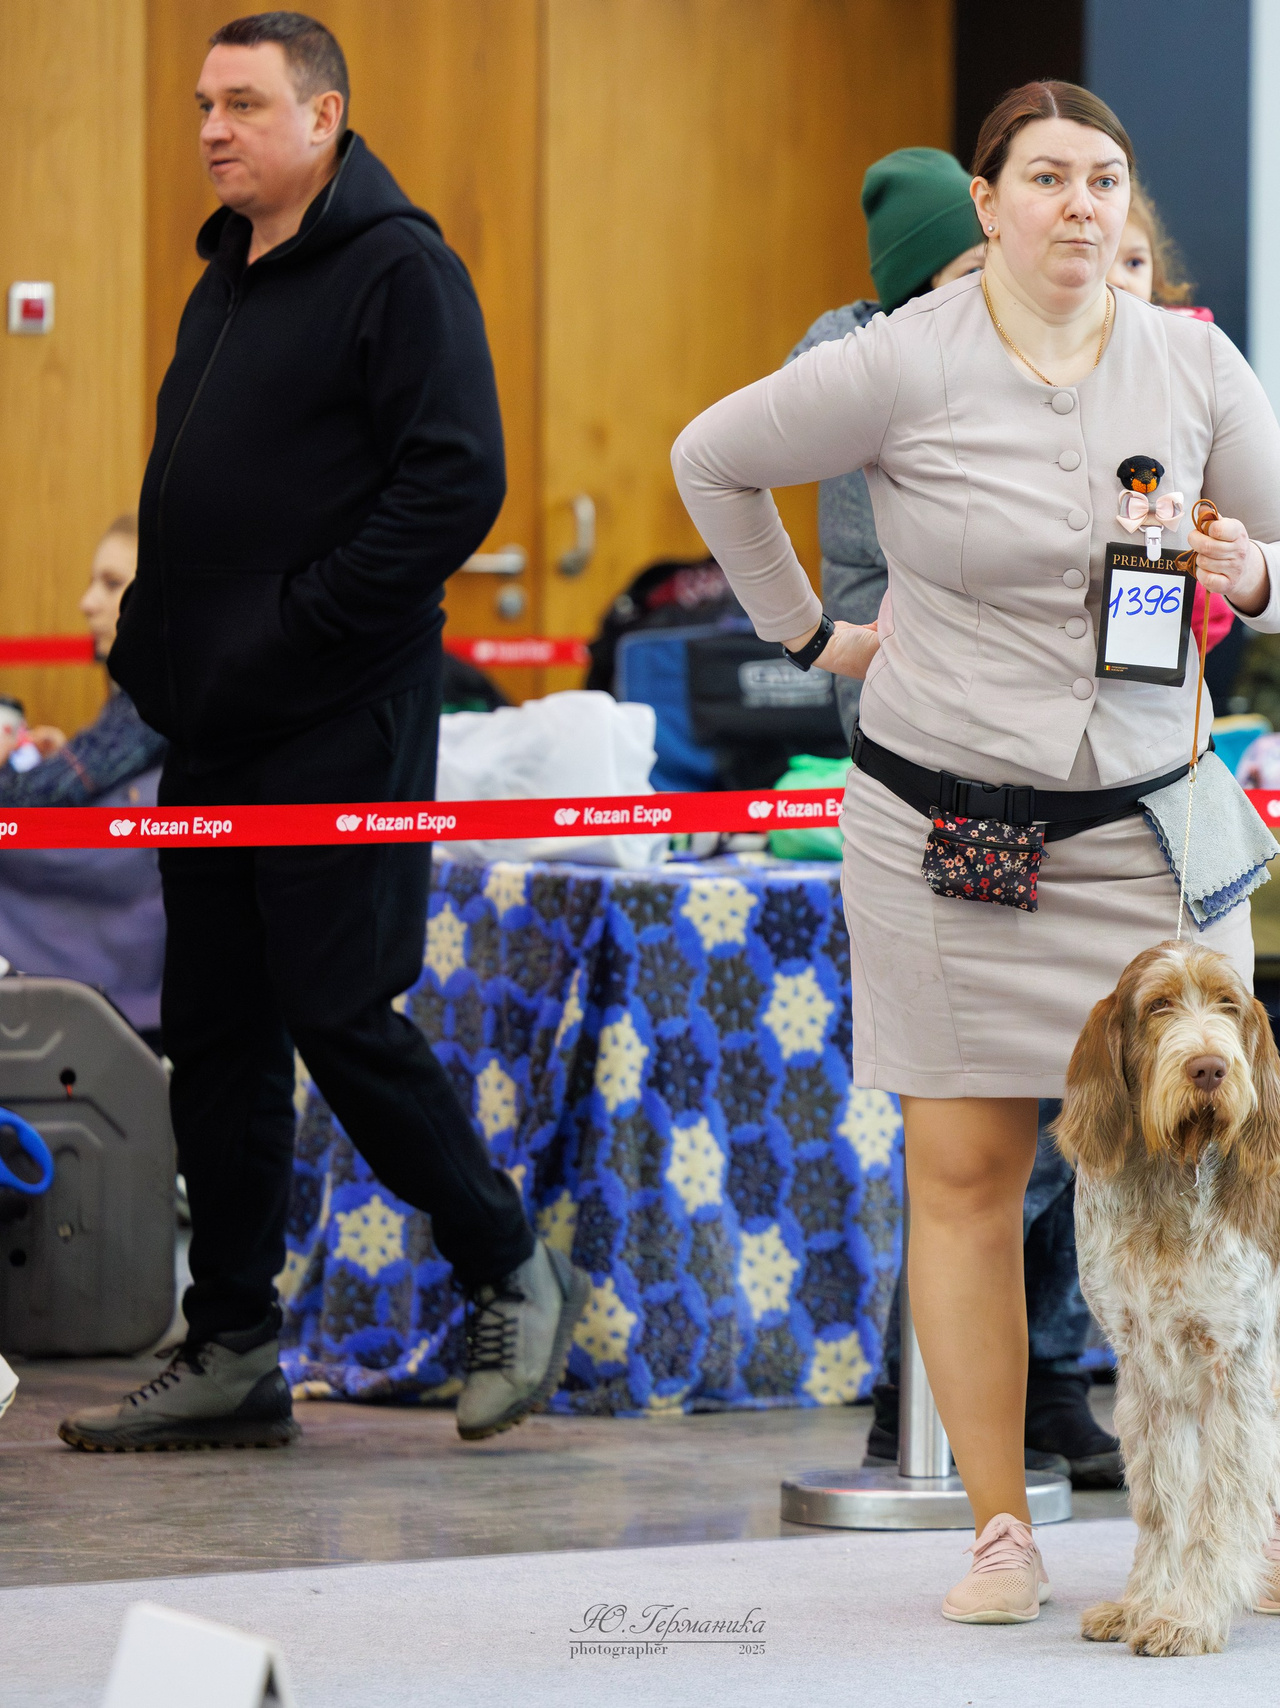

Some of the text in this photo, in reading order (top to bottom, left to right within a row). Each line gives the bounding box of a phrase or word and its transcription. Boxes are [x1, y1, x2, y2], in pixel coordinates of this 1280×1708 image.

[1112, 554, 1187, 573] PREMIER
[1109, 585, 1181, 618] 1396
[583, 805, 672, 827] Kazan Expo
[777, 798, 844, 818] Kazan Ex
[0, 821, 18, 840] po
[140, 816, 233, 838] Kazan Expo
[366, 812, 456, 834] Kazan Expo
